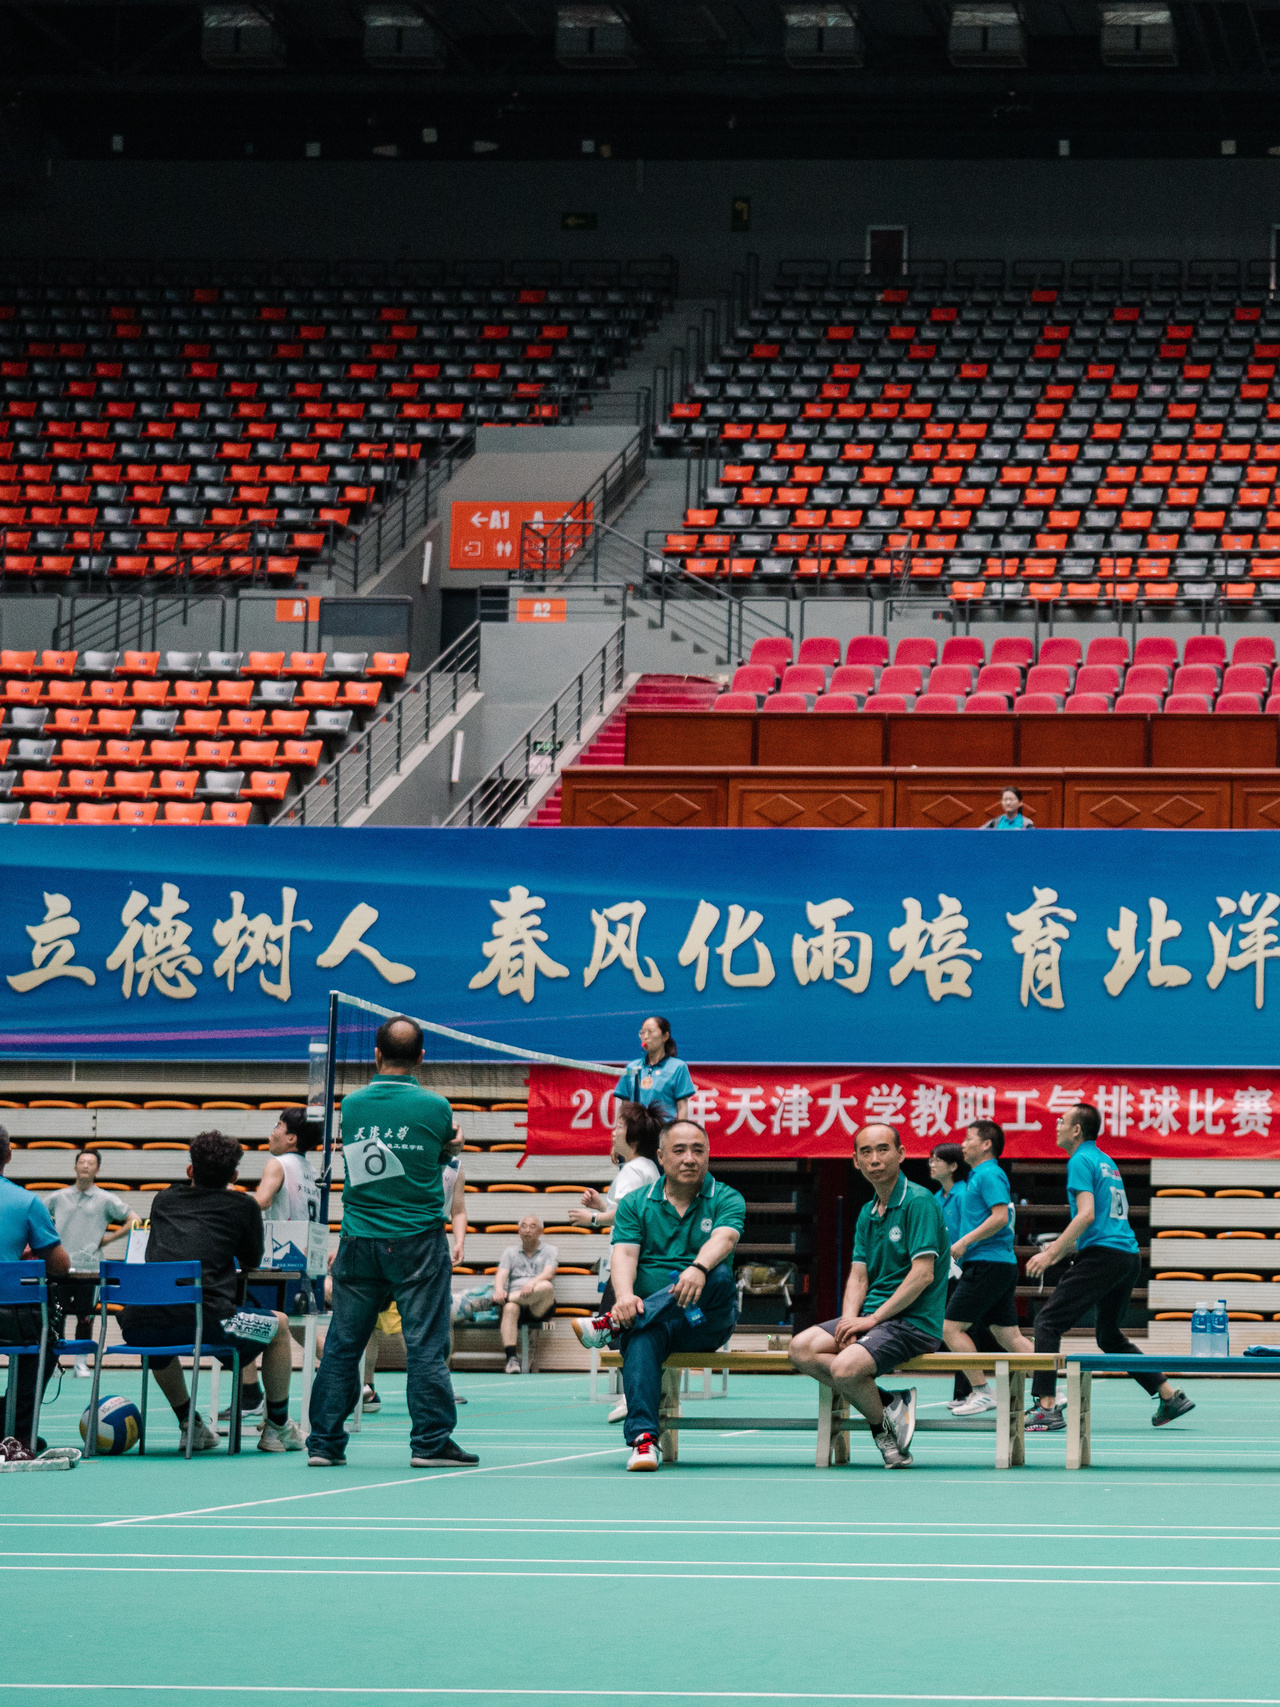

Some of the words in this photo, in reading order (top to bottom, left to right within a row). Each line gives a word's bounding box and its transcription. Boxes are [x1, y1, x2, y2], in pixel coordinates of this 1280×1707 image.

[489, 510, 510, 529] A1
[293, 600, 307, 617] A
[533, 601, 551, 618] A2
[5, 882, 416, 1002] 立德树人
[570, 1084, 1273, 1138] 20年天津大学教职工气排球比赛
